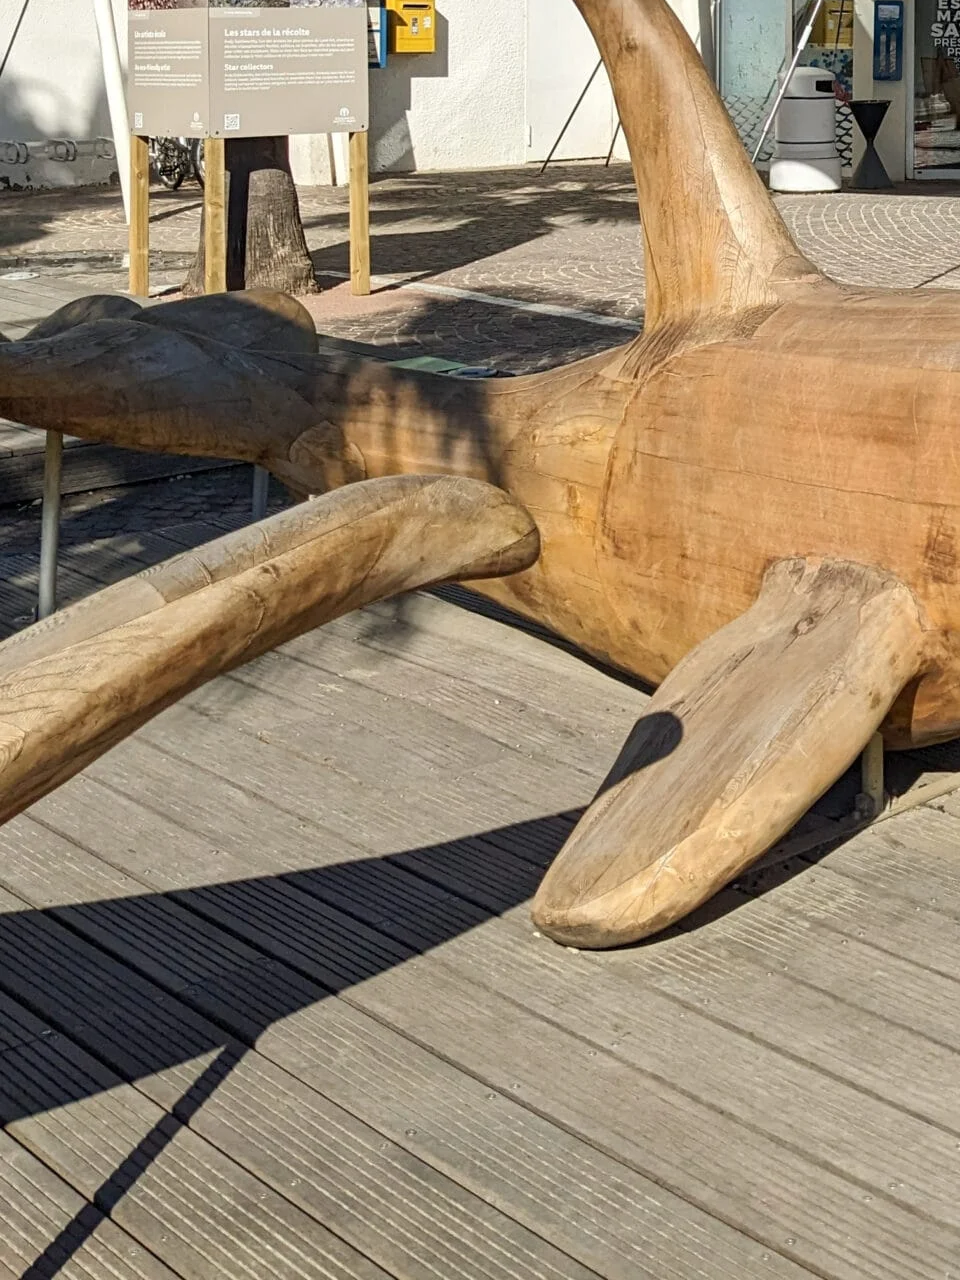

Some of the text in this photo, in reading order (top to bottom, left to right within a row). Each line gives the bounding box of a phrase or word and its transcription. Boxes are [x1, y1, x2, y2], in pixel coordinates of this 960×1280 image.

[261, 28, 272, 36] de
[273, 28, 280, 36] la
[282, 28, 310, 36] récolte
